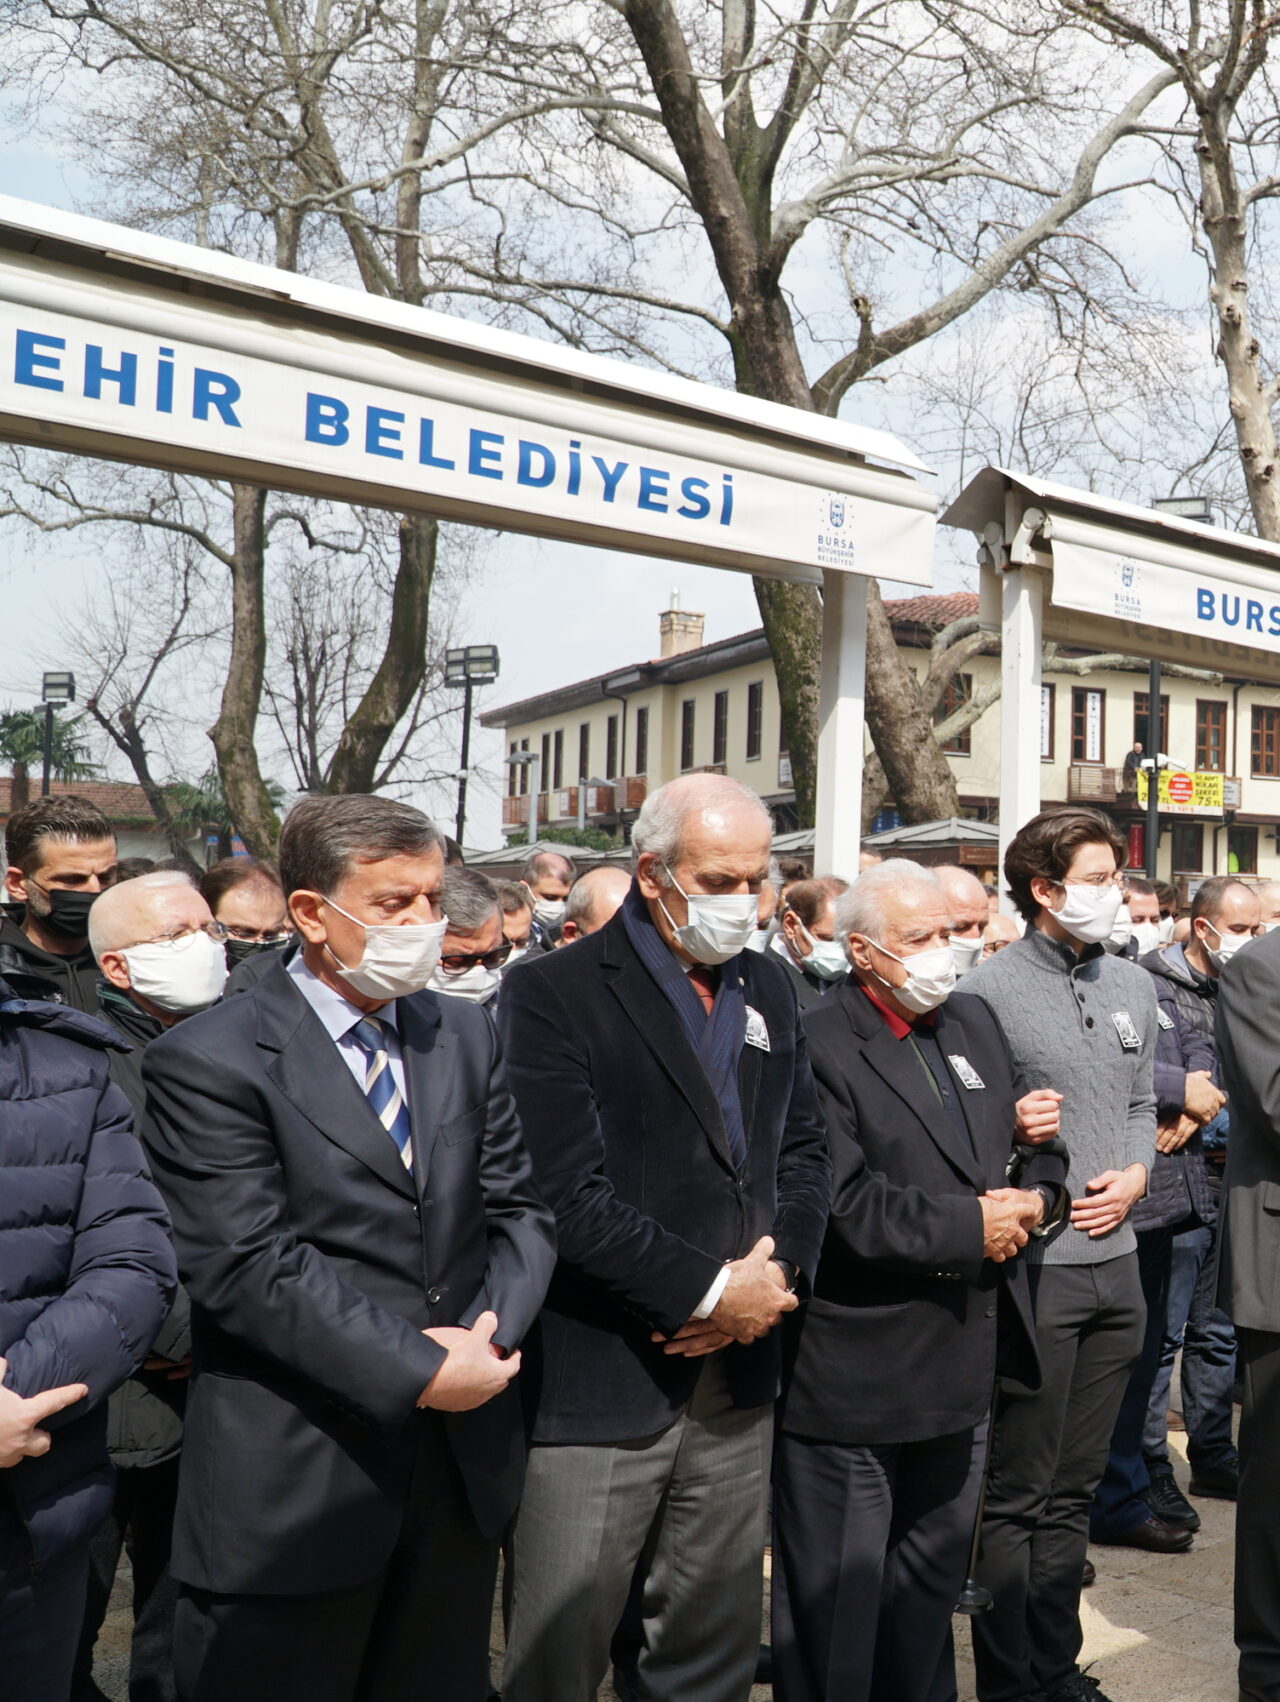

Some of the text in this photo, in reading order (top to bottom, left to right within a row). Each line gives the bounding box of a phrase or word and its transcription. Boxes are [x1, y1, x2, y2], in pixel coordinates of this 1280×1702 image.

[13, 328, 735, 527] EHİR BELEDİYESİ
[817, 534, 855, 550] BURSA
[1198, 796, 1211, 807] 75
